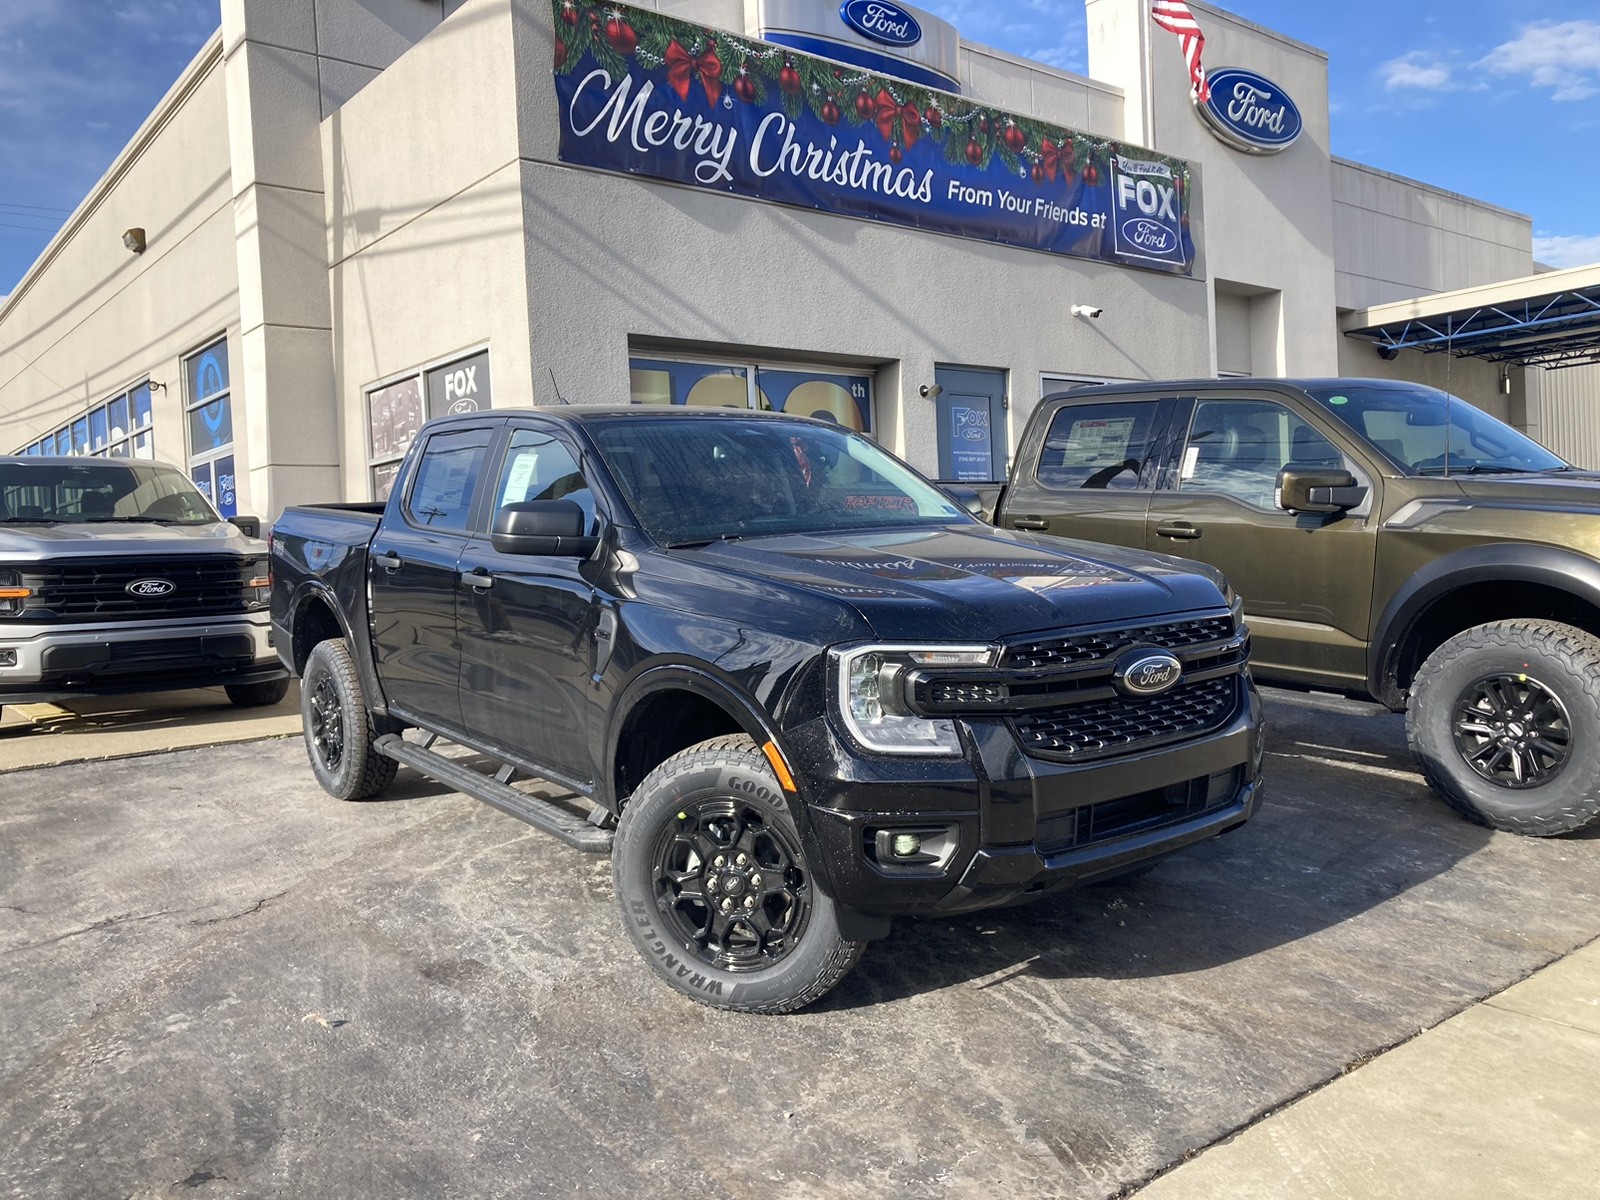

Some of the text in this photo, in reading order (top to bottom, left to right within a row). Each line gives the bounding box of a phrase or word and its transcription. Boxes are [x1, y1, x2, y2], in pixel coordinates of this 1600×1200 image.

[862, 4, 908, 38] Ford
[1228, 82, 1285, 134] Ford
[569, 69, 934, 203] Merry Christmas
[947, 179, 1107, 229] From Your Friends at
[1117, 173, 1177, 222] FOX
[1134, 221, 1167, 248] Ford
[444, 365, 478, 401] FOX
[952, 407, 988, 438] FOX
[844, 496, 917, 514] RAPTOR
[139, 582, 165, 593] Ford
[1140, 663, 1170, 686] Ford
[630, 900, 723, 996] WRANGLER
